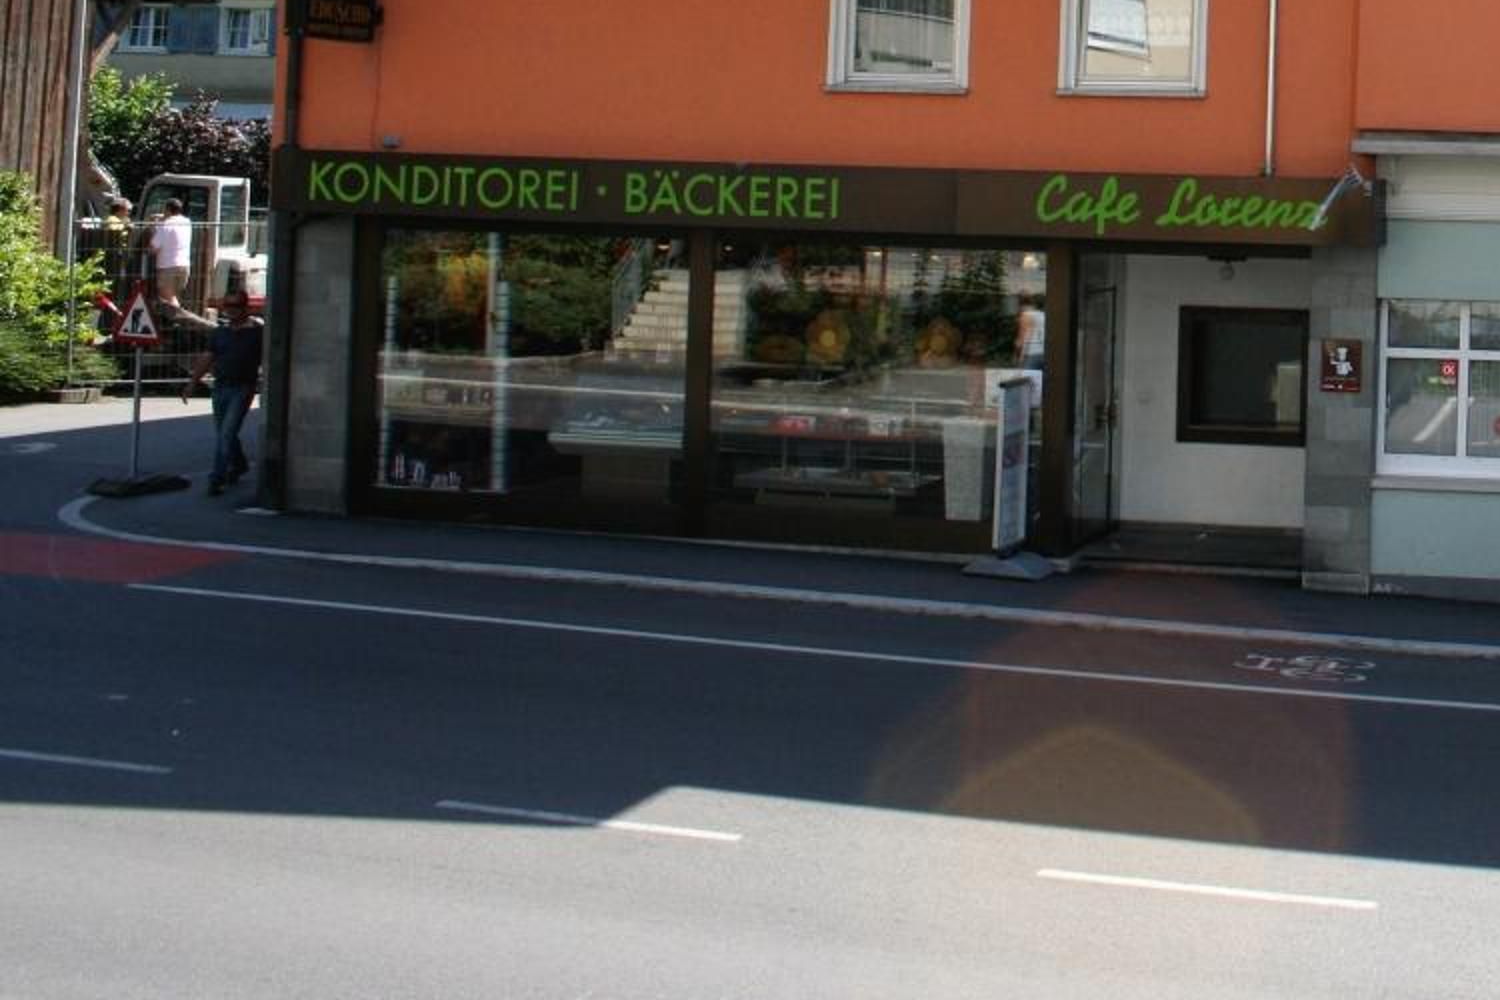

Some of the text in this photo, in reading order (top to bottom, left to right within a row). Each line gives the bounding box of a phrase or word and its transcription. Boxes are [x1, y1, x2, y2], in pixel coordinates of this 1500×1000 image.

[308, 161, 840, 219] KONDITOREI BÄCKEREI
[1035, 173, 1329, 235] Cafe Lorenz
